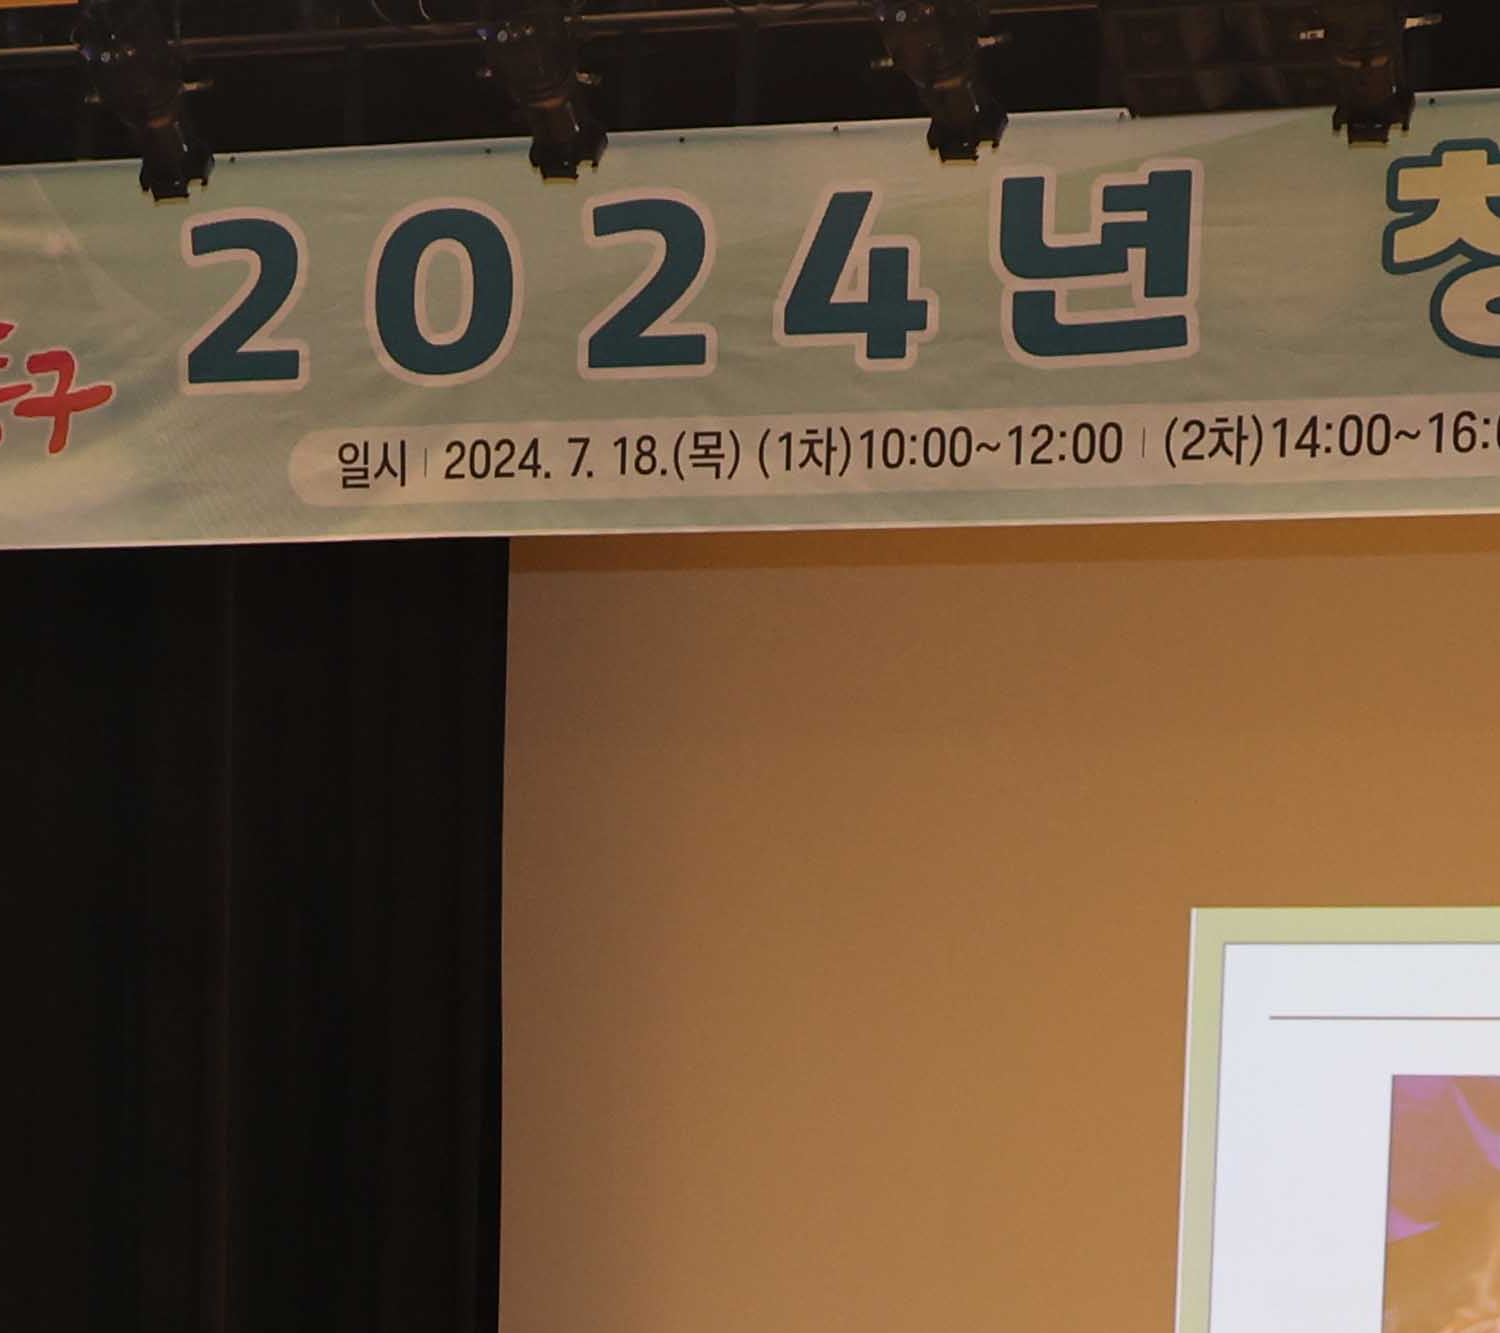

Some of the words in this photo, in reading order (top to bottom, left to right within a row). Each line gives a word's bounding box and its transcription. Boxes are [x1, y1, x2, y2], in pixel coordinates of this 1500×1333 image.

[184, 162, 1198, 390] 2024년
[338, 440, 407, 488] 일시
[444, 438, 552, 481] 2024.
[567, 437, 594, 479] 7.
[613, 430, 740, 481] 18.(목)
